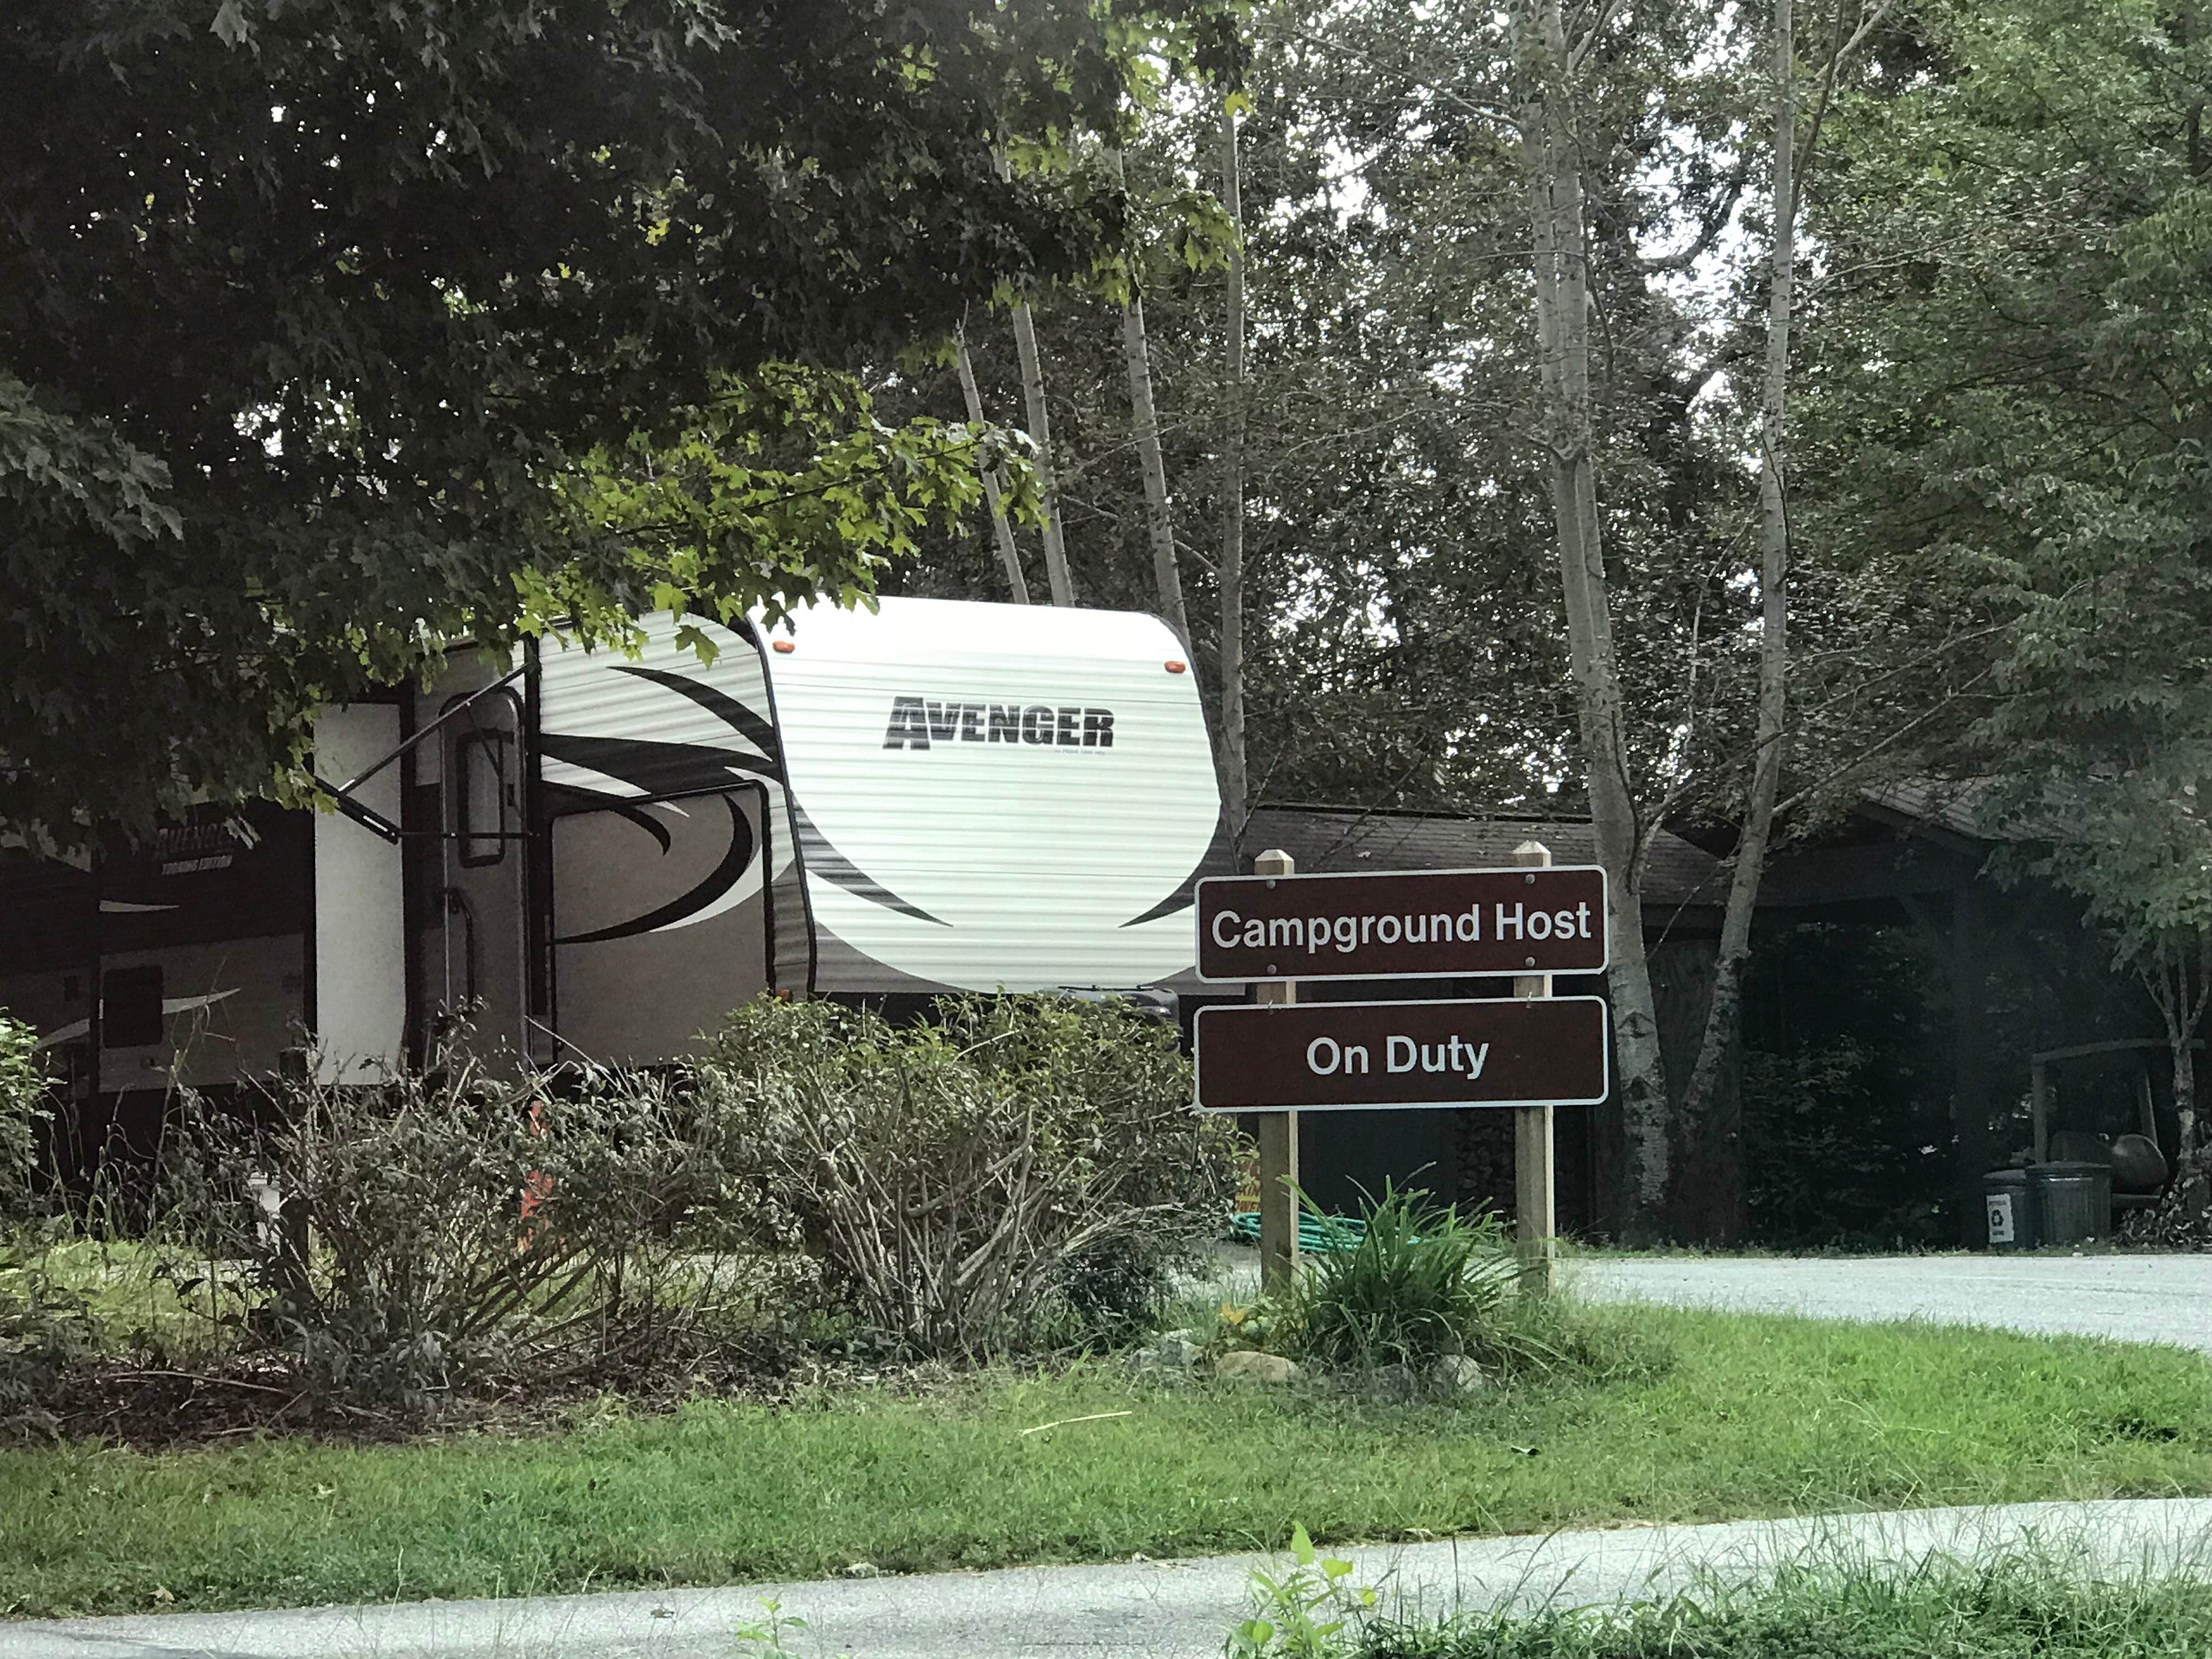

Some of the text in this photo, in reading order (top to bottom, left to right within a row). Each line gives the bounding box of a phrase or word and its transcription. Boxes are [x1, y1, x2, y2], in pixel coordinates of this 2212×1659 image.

[882, 696, 1115, 751] AVENGER
[1211, 901, 1592, 953] Campground Host
[1306, 1035, 1489, 1080] On Duty
